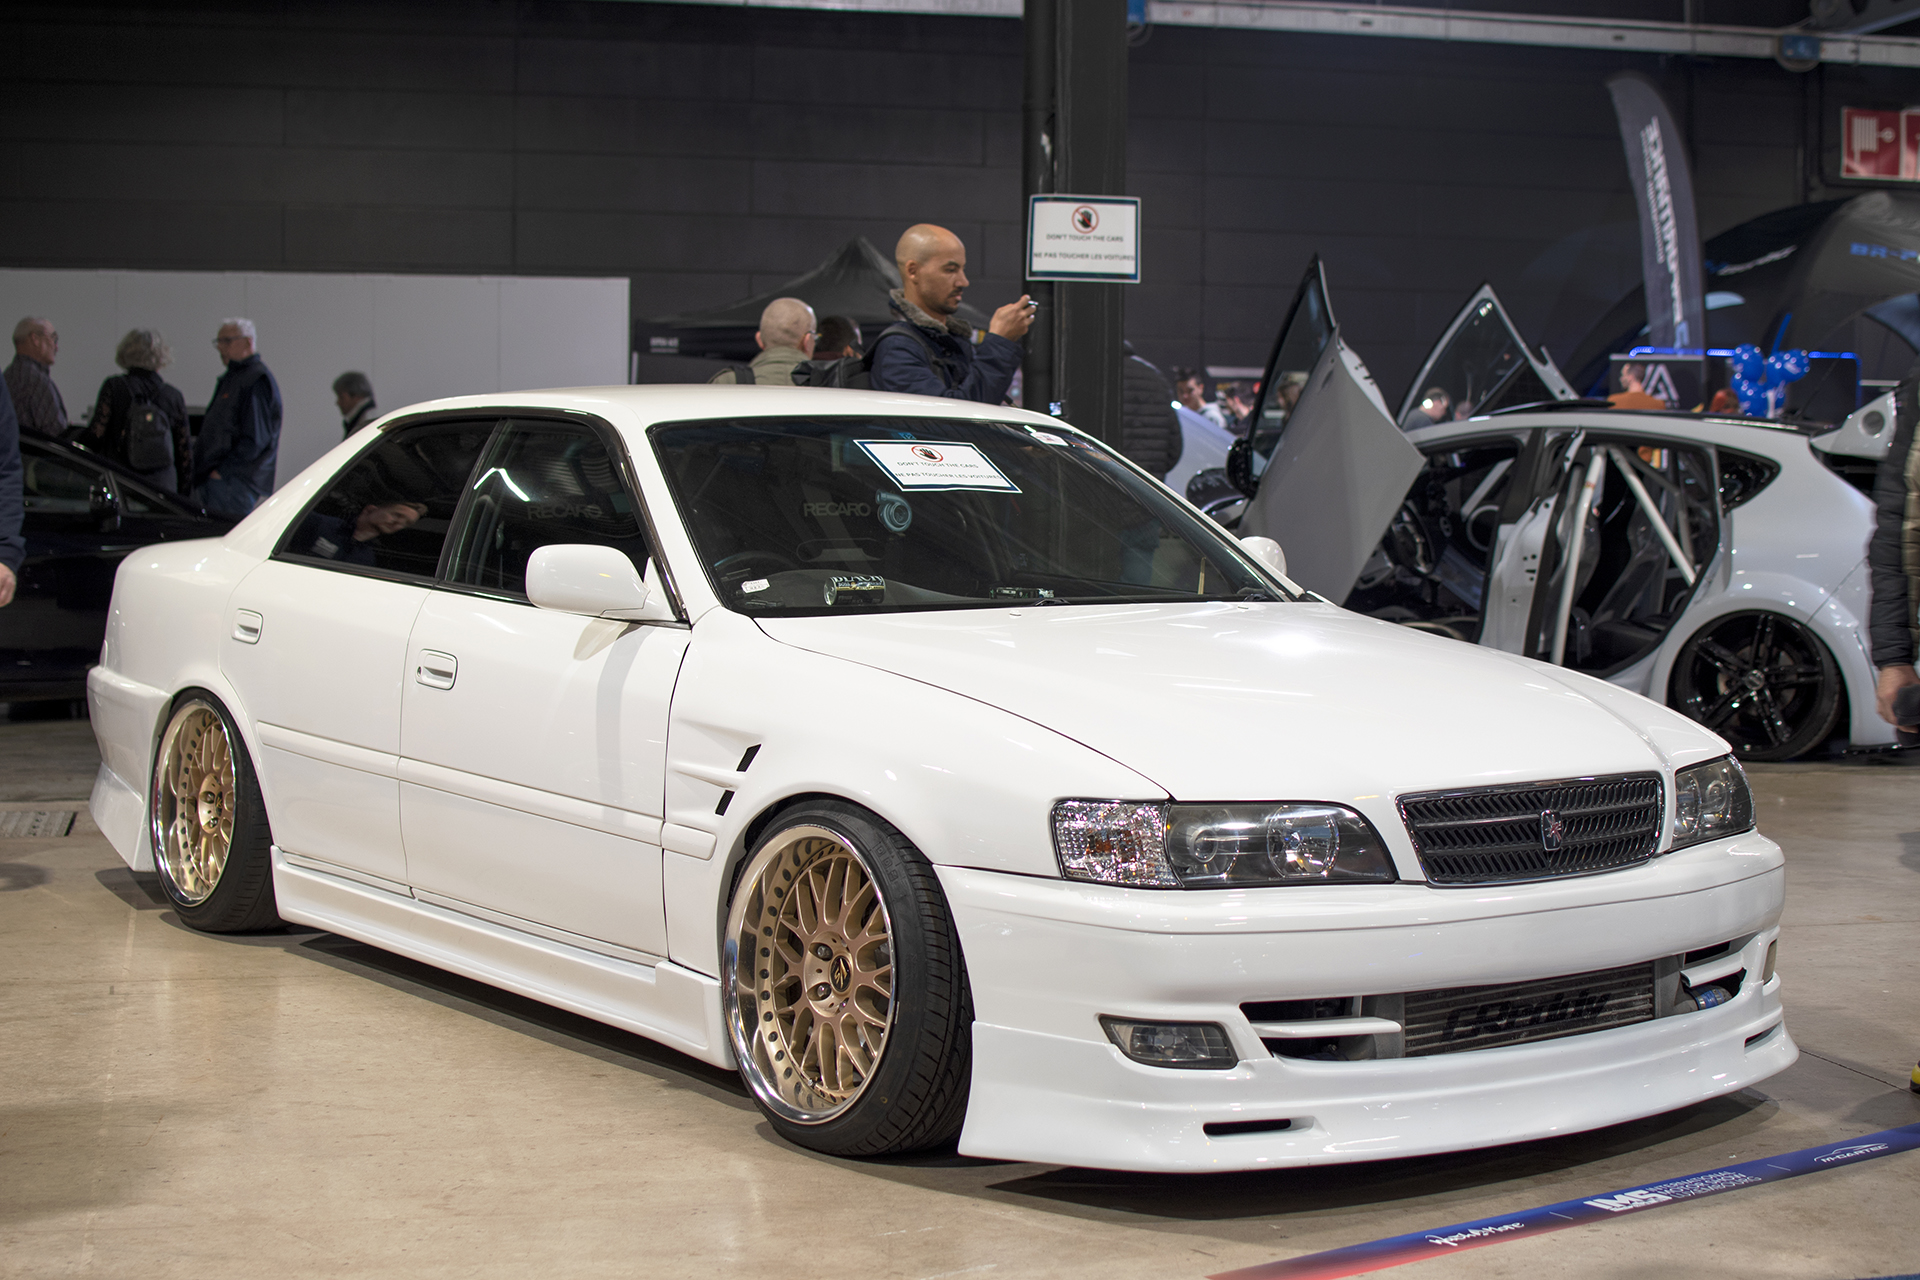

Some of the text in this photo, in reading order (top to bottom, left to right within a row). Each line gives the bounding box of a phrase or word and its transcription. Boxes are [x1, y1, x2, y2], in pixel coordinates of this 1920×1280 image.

[1059, 252, 1090, 260] TOUCHER
[1104, 253, 1135, 261] VOITURES
[527, 503, 603, 520] RECARO
[803, 502, 871, 517] RECARO
[1583, 1190, 1672, 1212] IMS
